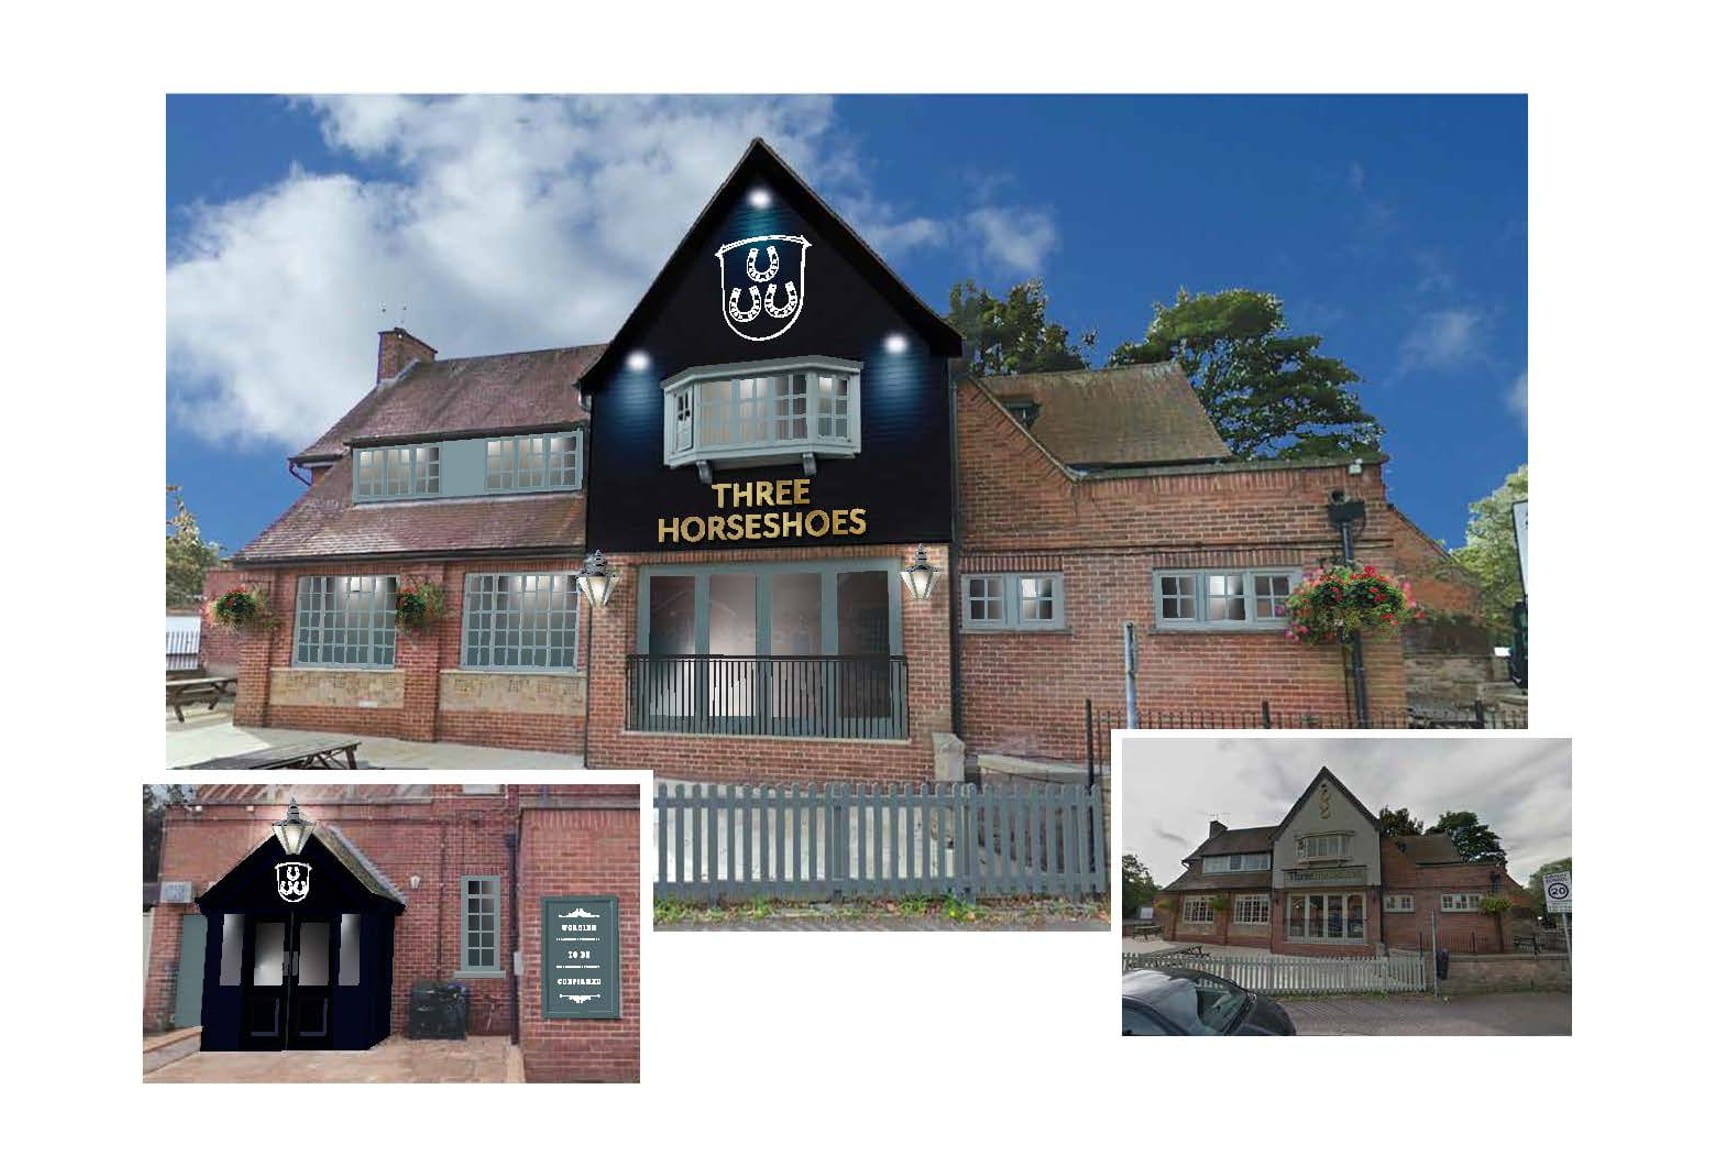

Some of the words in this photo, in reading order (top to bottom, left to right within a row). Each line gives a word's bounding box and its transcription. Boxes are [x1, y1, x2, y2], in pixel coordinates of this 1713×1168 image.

[711, 478, 811, 508] THREE
[658, 508, 867, 543] HORSESHOES
[1551, 887, 1566, 895] 20
